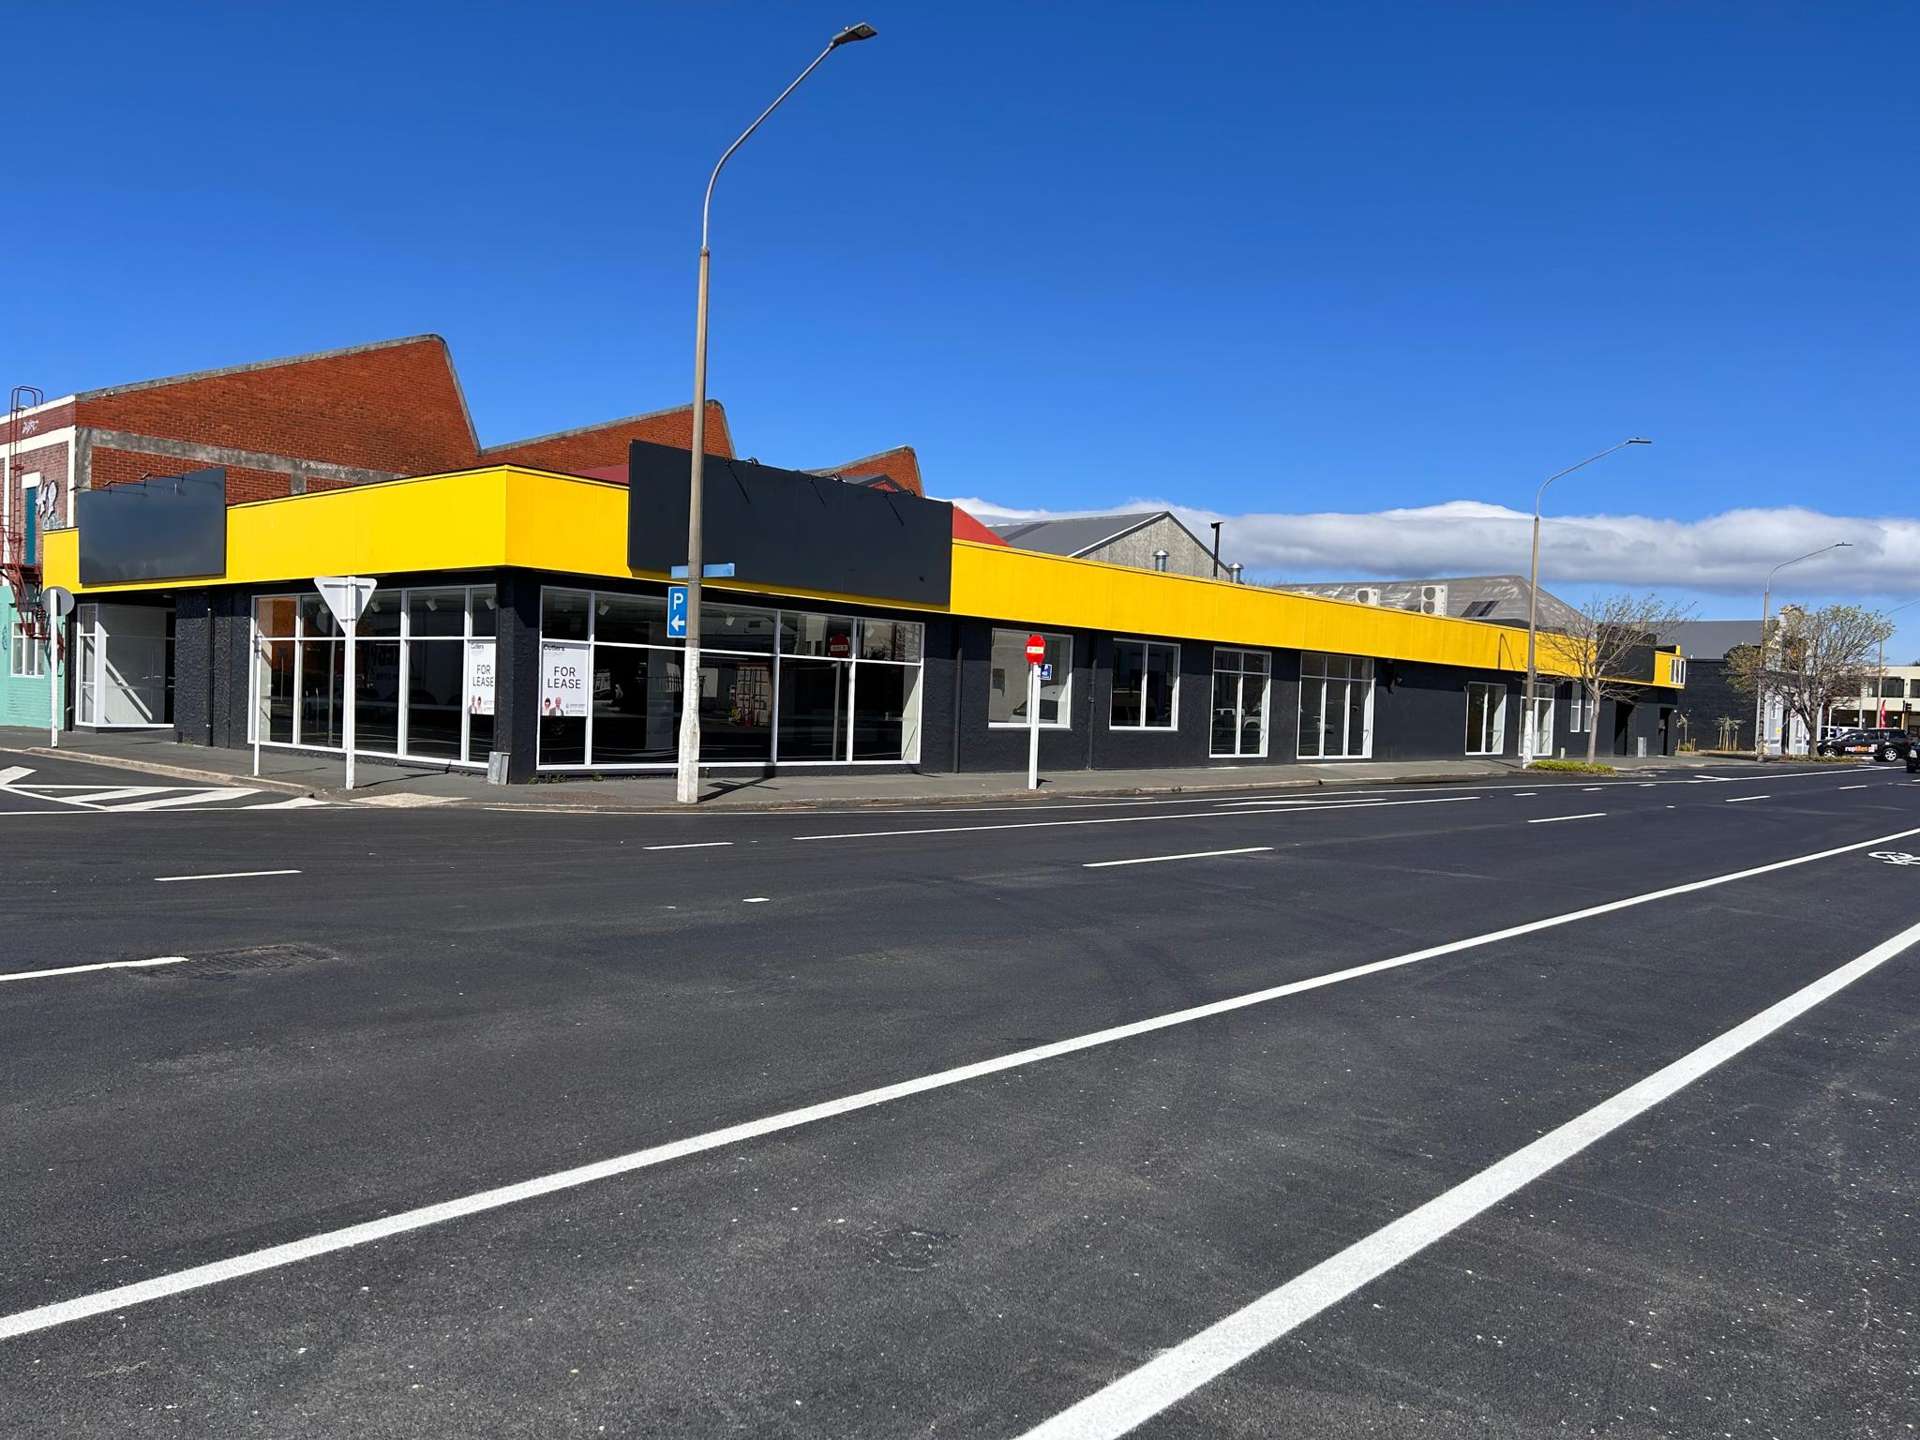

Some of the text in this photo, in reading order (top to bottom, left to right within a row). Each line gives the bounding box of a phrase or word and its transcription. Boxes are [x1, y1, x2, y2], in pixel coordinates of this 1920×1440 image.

[673, 592, 684, 610] P
[476, 664, 491, 675] FOR
[554, 666, 576, 677] FOR
[472, 676, 494, 688] LEASE
[547, 678, 582, 689] LEASE
